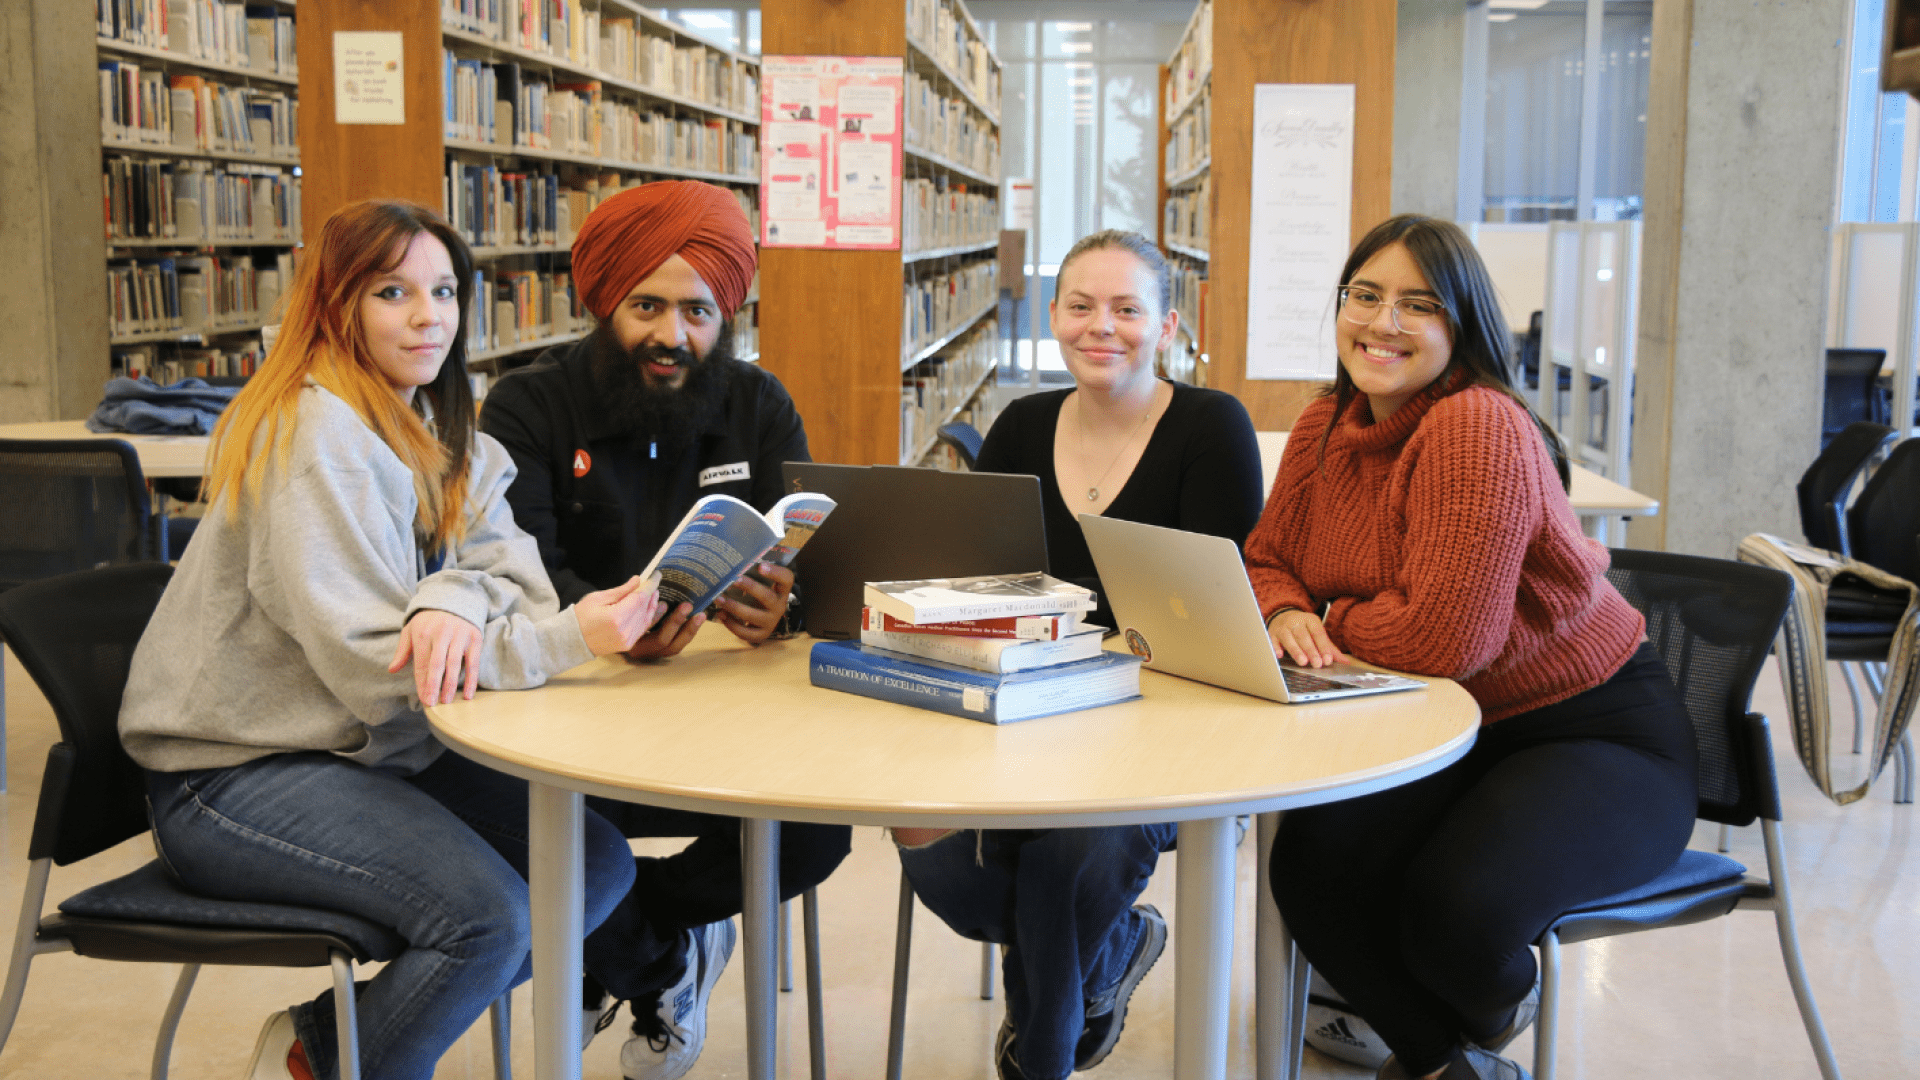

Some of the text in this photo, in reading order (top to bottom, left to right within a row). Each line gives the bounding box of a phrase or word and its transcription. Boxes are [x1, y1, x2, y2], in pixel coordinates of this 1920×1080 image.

[703, 467, 744, 481] AIRWALK
[959, 605, 1002, 617] Margaret
[1005, 599, 1056, 612] Macdonald
[816, 663, 824, 673] A
[825, 665, 870, 682] TRADITION
[871, 673, 883, 685] OF
[884, 676, 942, 698] EXCELLENCE
[1315, 1029, 1368, 1048] adidas
